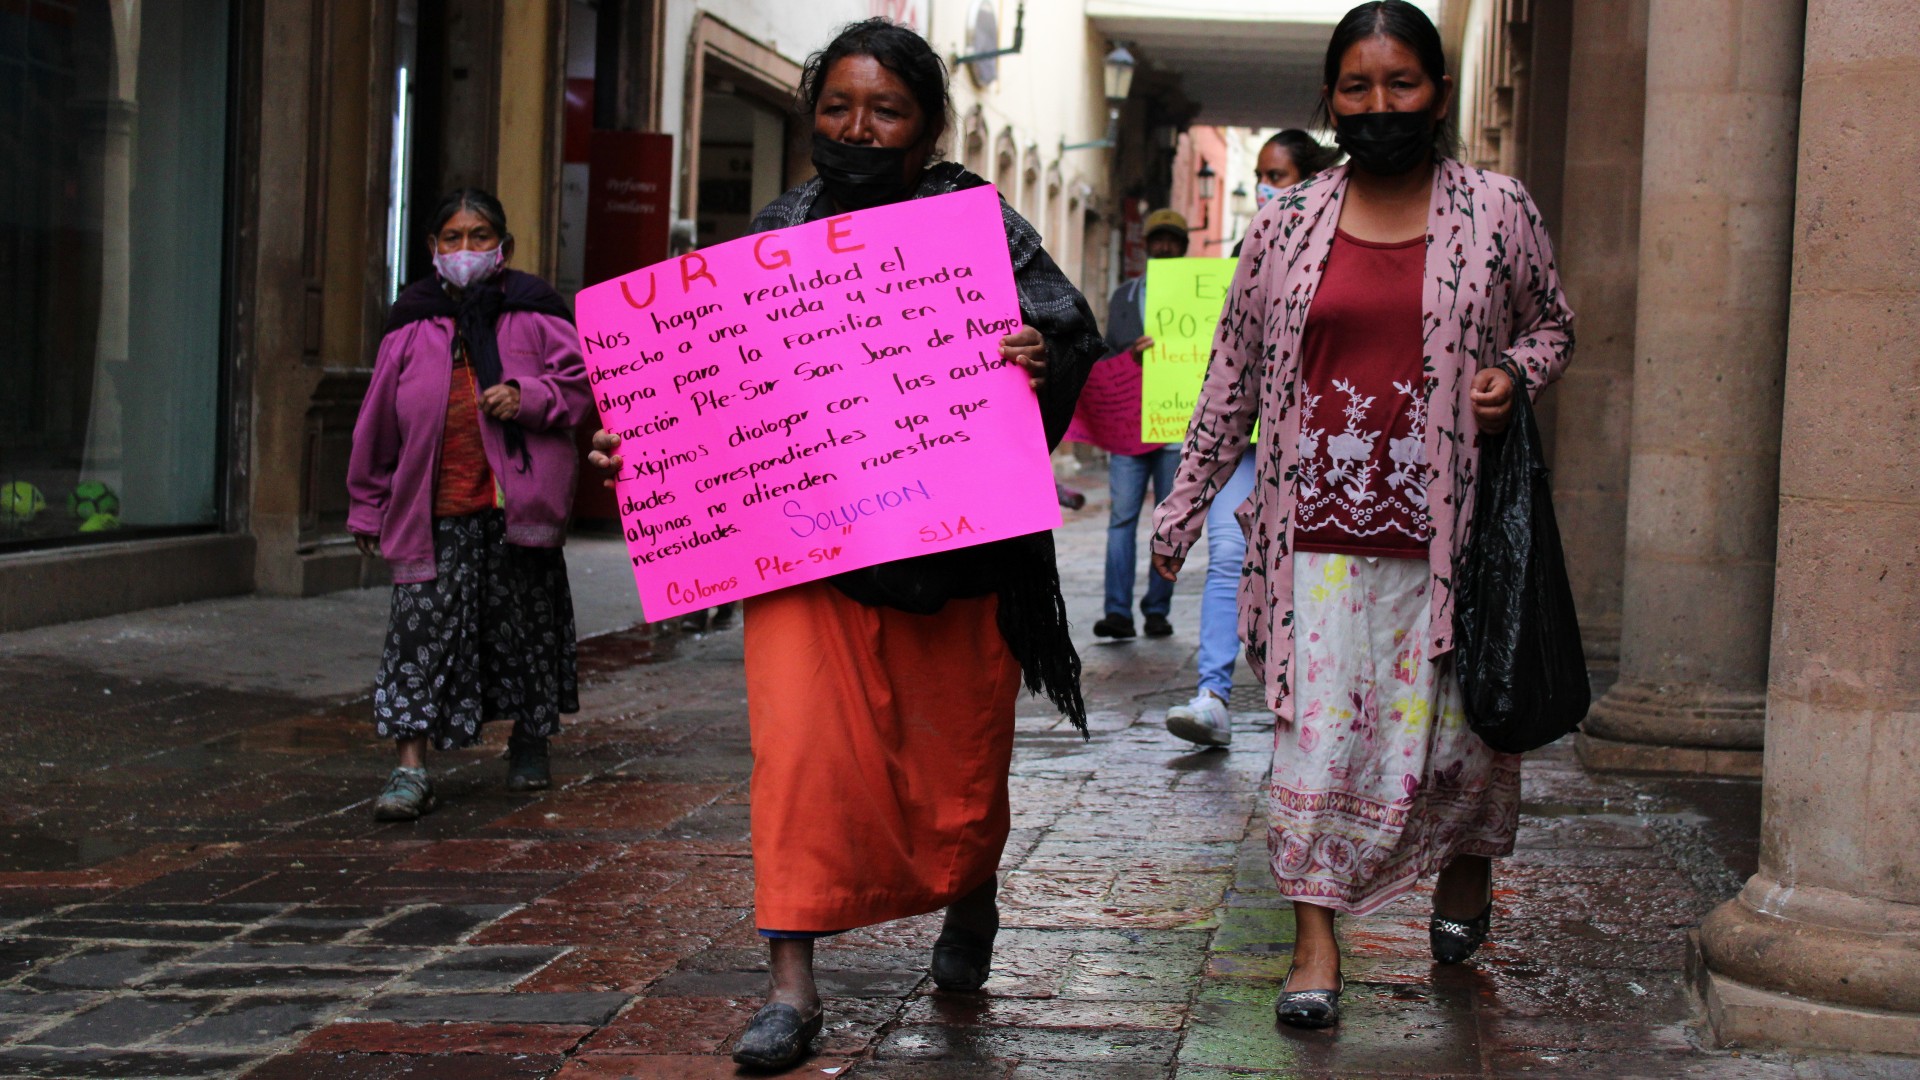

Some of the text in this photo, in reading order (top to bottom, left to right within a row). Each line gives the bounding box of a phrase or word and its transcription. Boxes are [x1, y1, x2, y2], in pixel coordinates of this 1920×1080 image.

[583, 246, 905, 354] Nos hagan realidad el
[619, 214, 866, 310] URGE
[590, 266, 973, 386] derecho a una vida y vienda
[598, 286, 986, 413] digna para la Familia en la
[690, 379, 780, 416] Pte-Sur
[794, 361, 844, 382] San
[861, 342, 912, 365] Juan
[927, 328, 955, 348] de
[965, 314, 1020, 340] Abajo
[621, 398, 991, 516] dades correspondientes ya que
[728, 409, 809, 448] dialogar
[826, 395, 869, 414] con
[893, 372, 936, 395] las
[627, 429, 971, 547] algunas no atienden nuestras
[666, 576, 738, 606] Colonos
